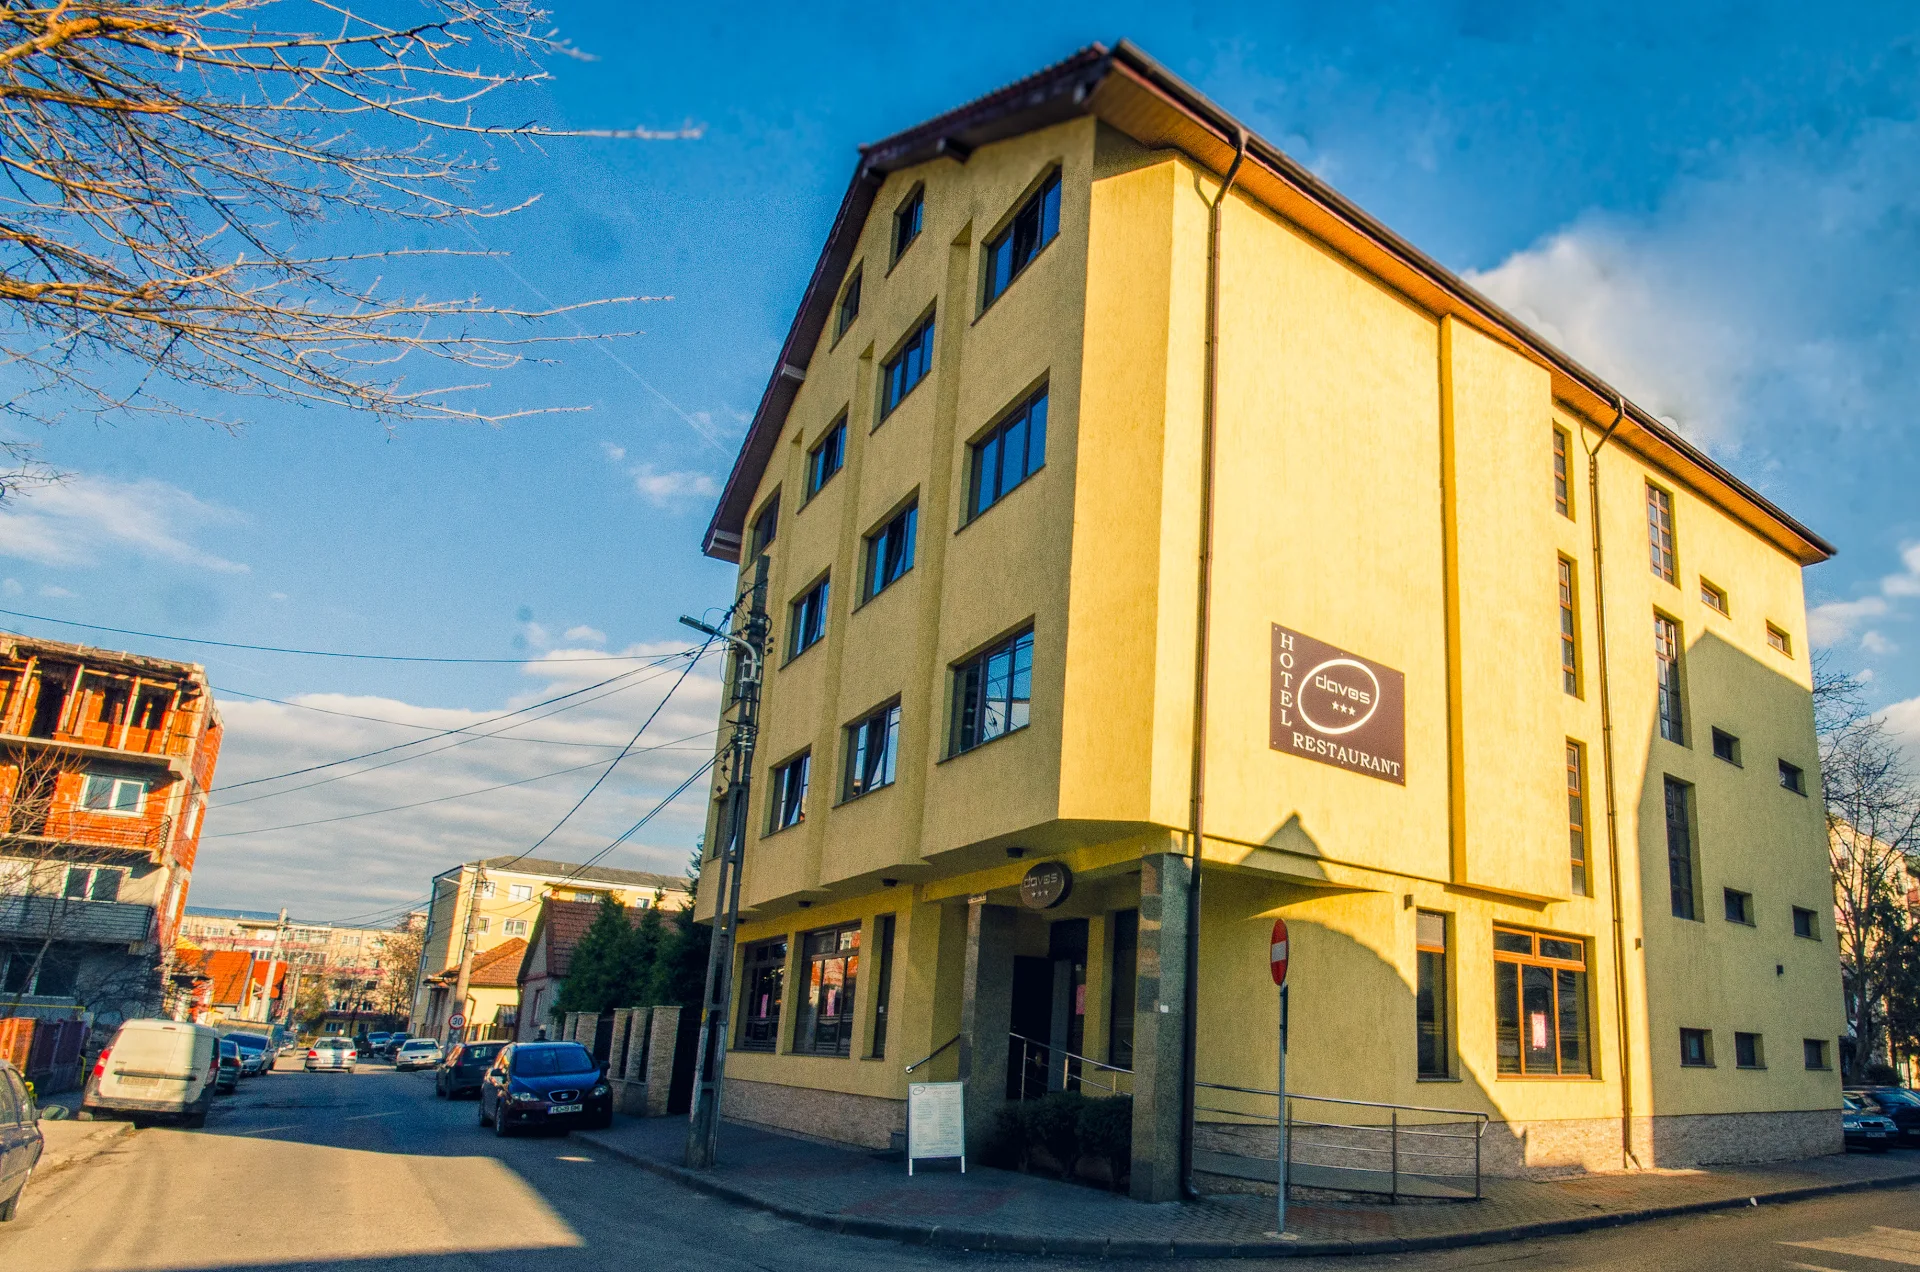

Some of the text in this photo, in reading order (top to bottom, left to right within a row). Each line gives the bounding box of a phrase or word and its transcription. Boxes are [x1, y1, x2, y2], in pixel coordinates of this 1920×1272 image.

[1279, 632, 1294, 727] HOTEL
[1315, 674, 1370, 705] davos
[1292, 731, 1401, 777] RESTAURANT
[452, 1017, 463, 1026] 30
